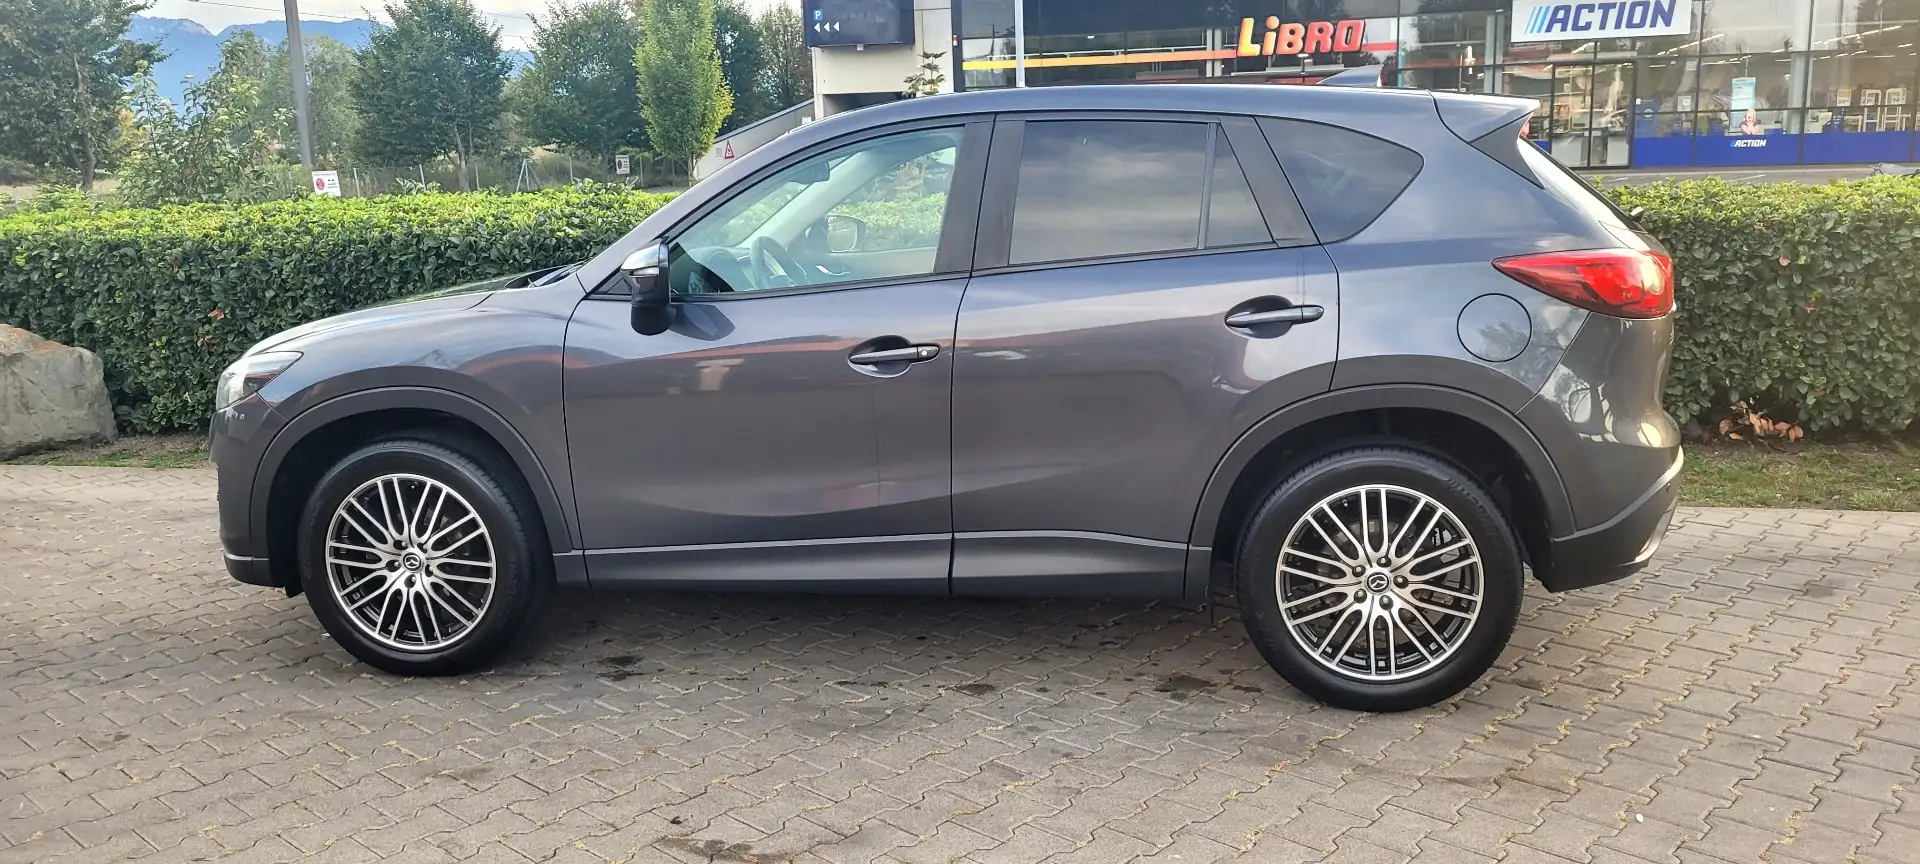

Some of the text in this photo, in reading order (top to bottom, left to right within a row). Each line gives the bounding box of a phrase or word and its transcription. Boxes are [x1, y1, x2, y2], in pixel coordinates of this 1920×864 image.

[815, 10, 821, 20] P
[1544, 0, 1677, 33] ACTION
[1735, 139, 1767, 147] ACTION
